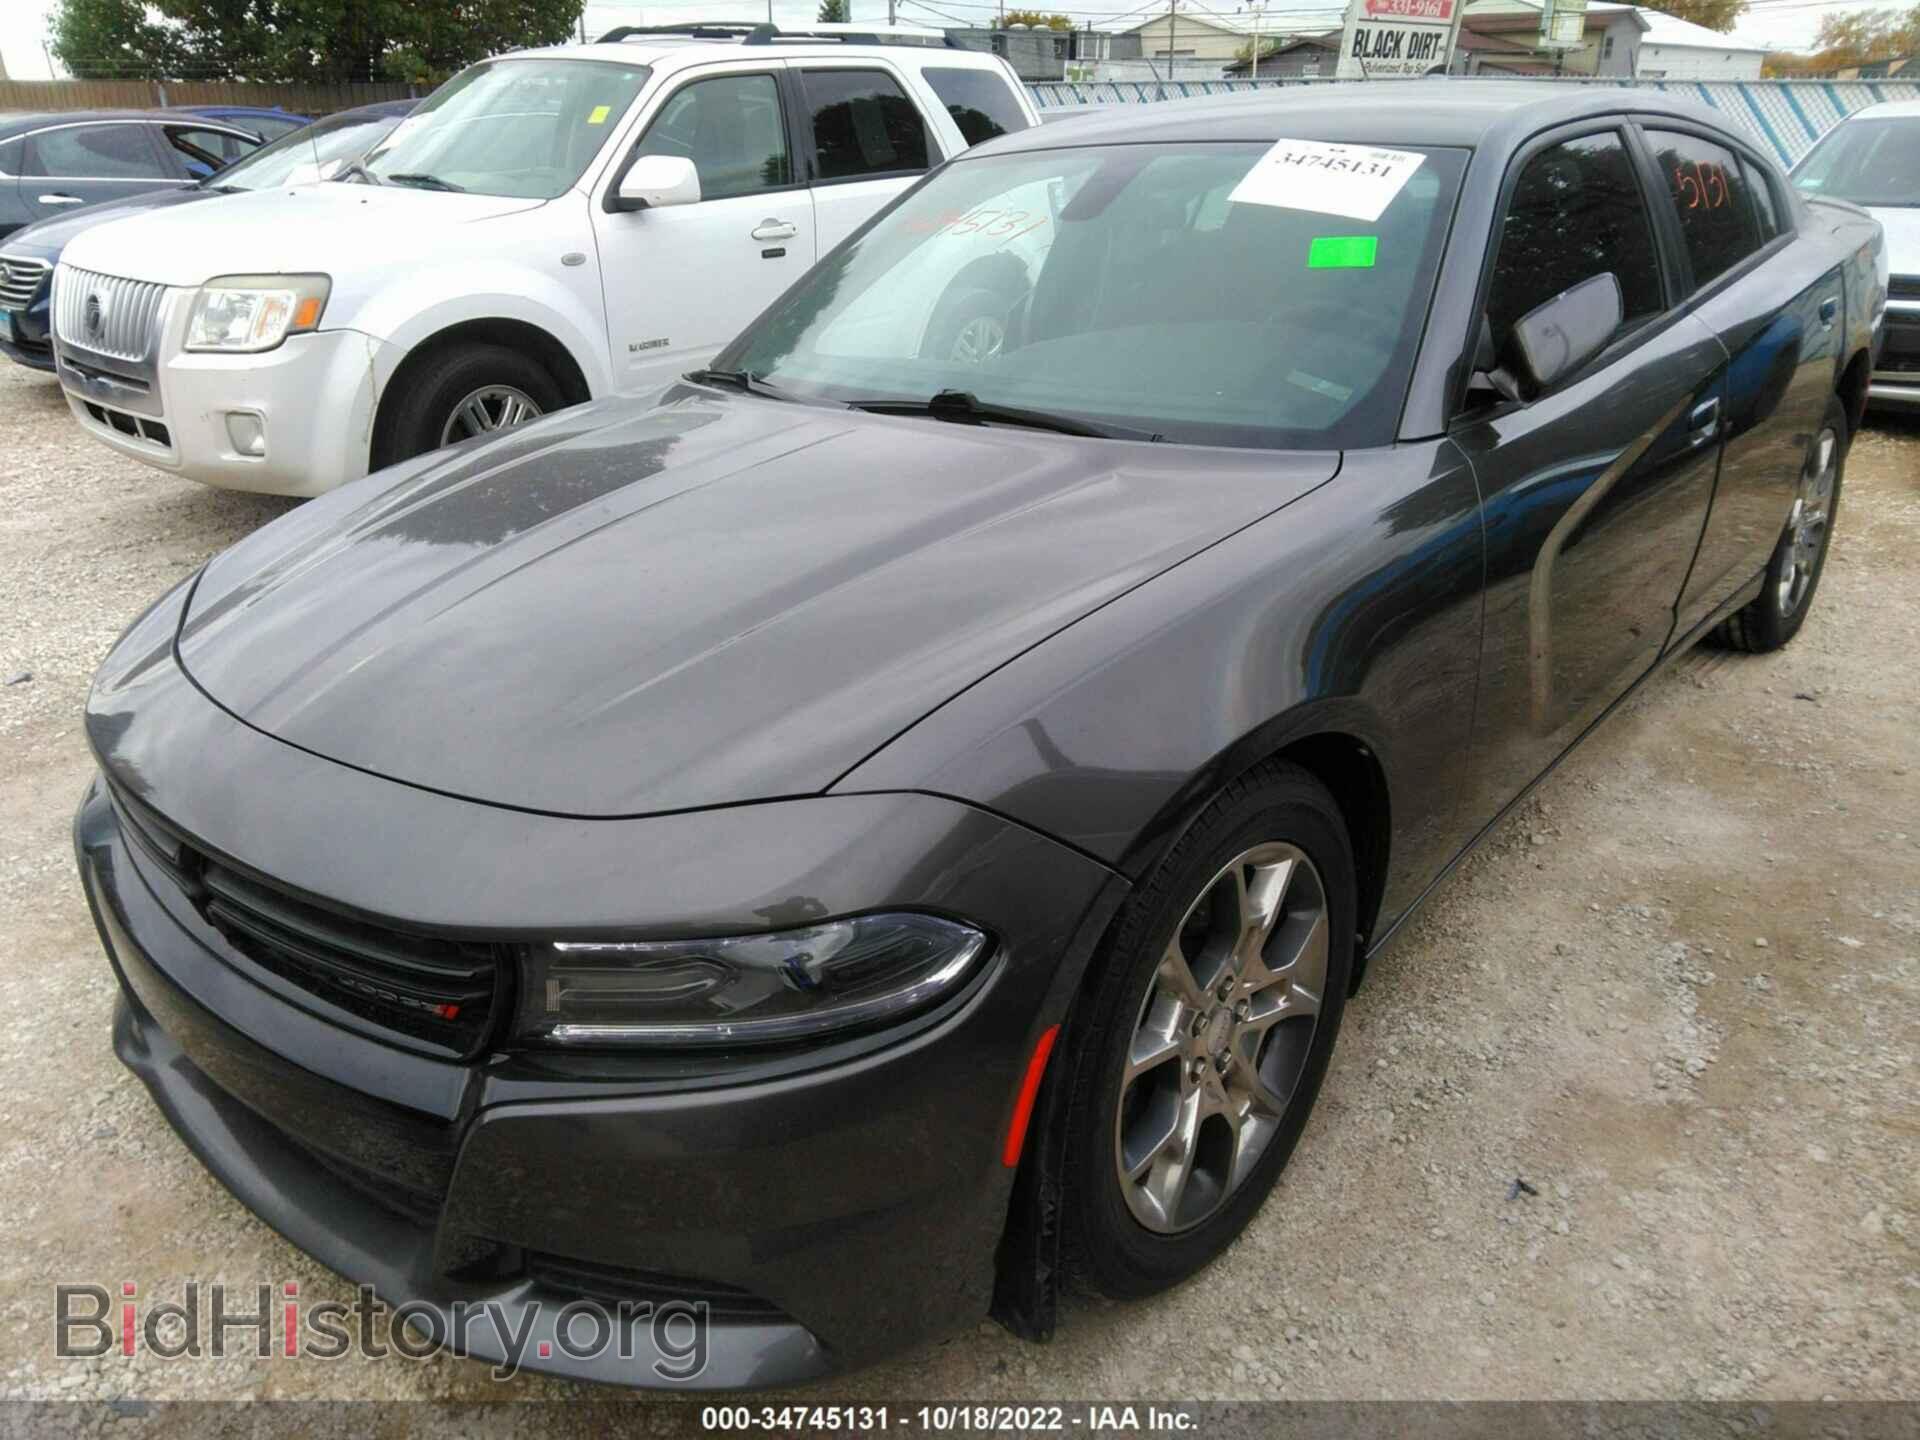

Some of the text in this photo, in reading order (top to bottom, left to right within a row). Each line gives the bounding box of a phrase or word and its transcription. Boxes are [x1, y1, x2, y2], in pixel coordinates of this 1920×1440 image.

[1352, 28, 1442, 60] BLACK DIRT
[1275, 152, 1392, 177] 34745131
[1674, 160, 1732, 209] 5131
